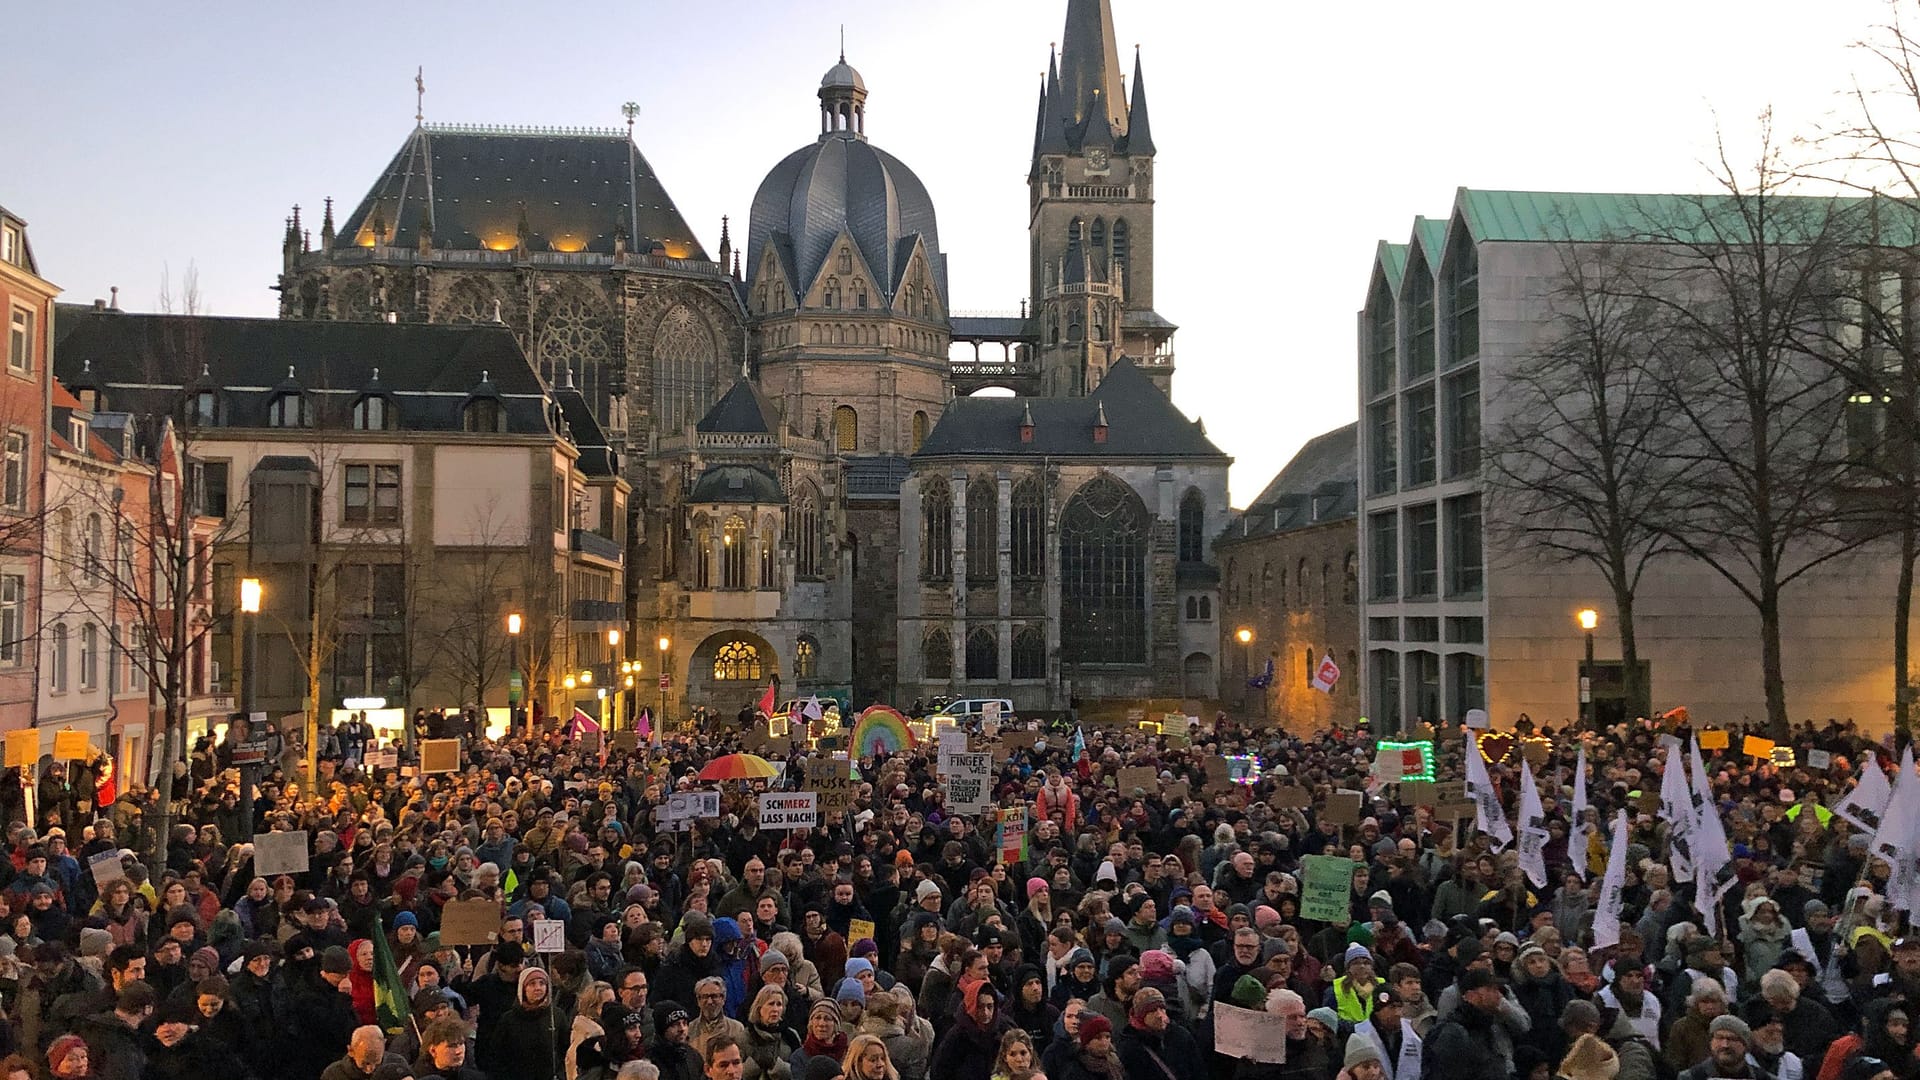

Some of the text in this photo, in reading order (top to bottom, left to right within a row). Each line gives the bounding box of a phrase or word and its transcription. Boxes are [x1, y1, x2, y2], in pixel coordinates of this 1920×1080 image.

[950, 756, 984, 766] FINGER
[969, 766, 987, 775] WEG
[811, 777, 846, 789] MUSK
[766, 799, 811, 810] SCHMERZ
[761, 812, 815, 824] LASS NACH!
